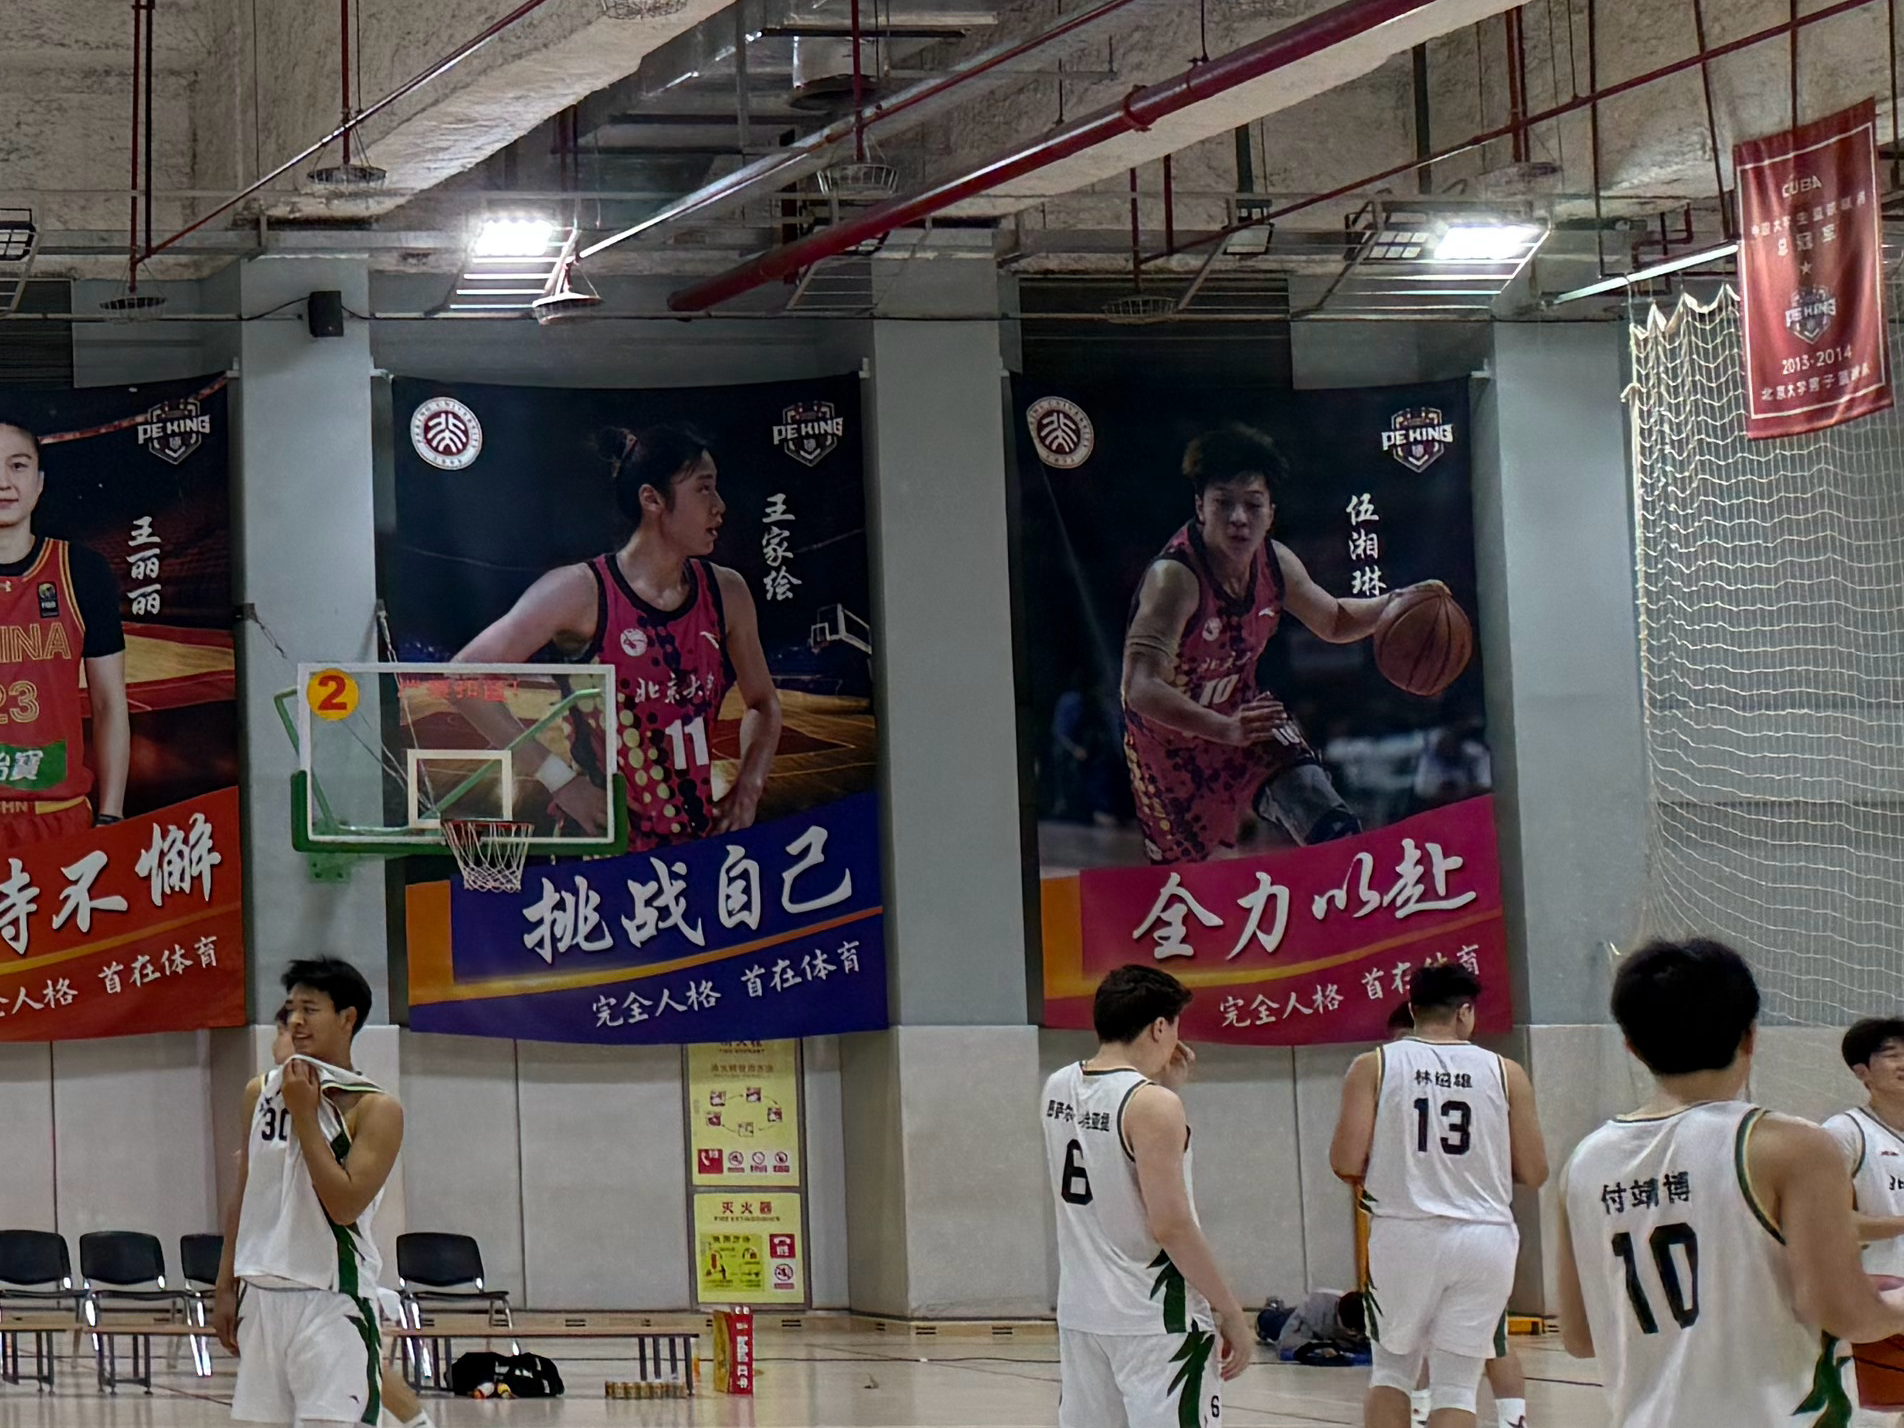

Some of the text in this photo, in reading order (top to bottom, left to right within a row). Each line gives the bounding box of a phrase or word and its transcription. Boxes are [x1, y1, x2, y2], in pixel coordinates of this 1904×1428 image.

[125, 515, 162, 617] 王丽丽
[761, 492, 803, 602] 王家绘
[1345, 492, 1387, 598] 伍湘琳
[318, 674, 348, 712] 2
[665, 716, 710, 770] 11
[522, 825, 853, 965] 挑战自己
[1132, 838, 1477, 961] 全力以赴
[97, 935, 218, 995] 首在体育
[592, 940, 861, 1028] 完全人格 首在体育
[1220, 984, 1344, 1028] 完全人格
[1414, 1097, 1472, 1155] 13
[1061, 1138, 1094, 1206] 6
[1611, 1222, 1700, 1335] 10
[1210, 1395, 1220, 1419] 6
